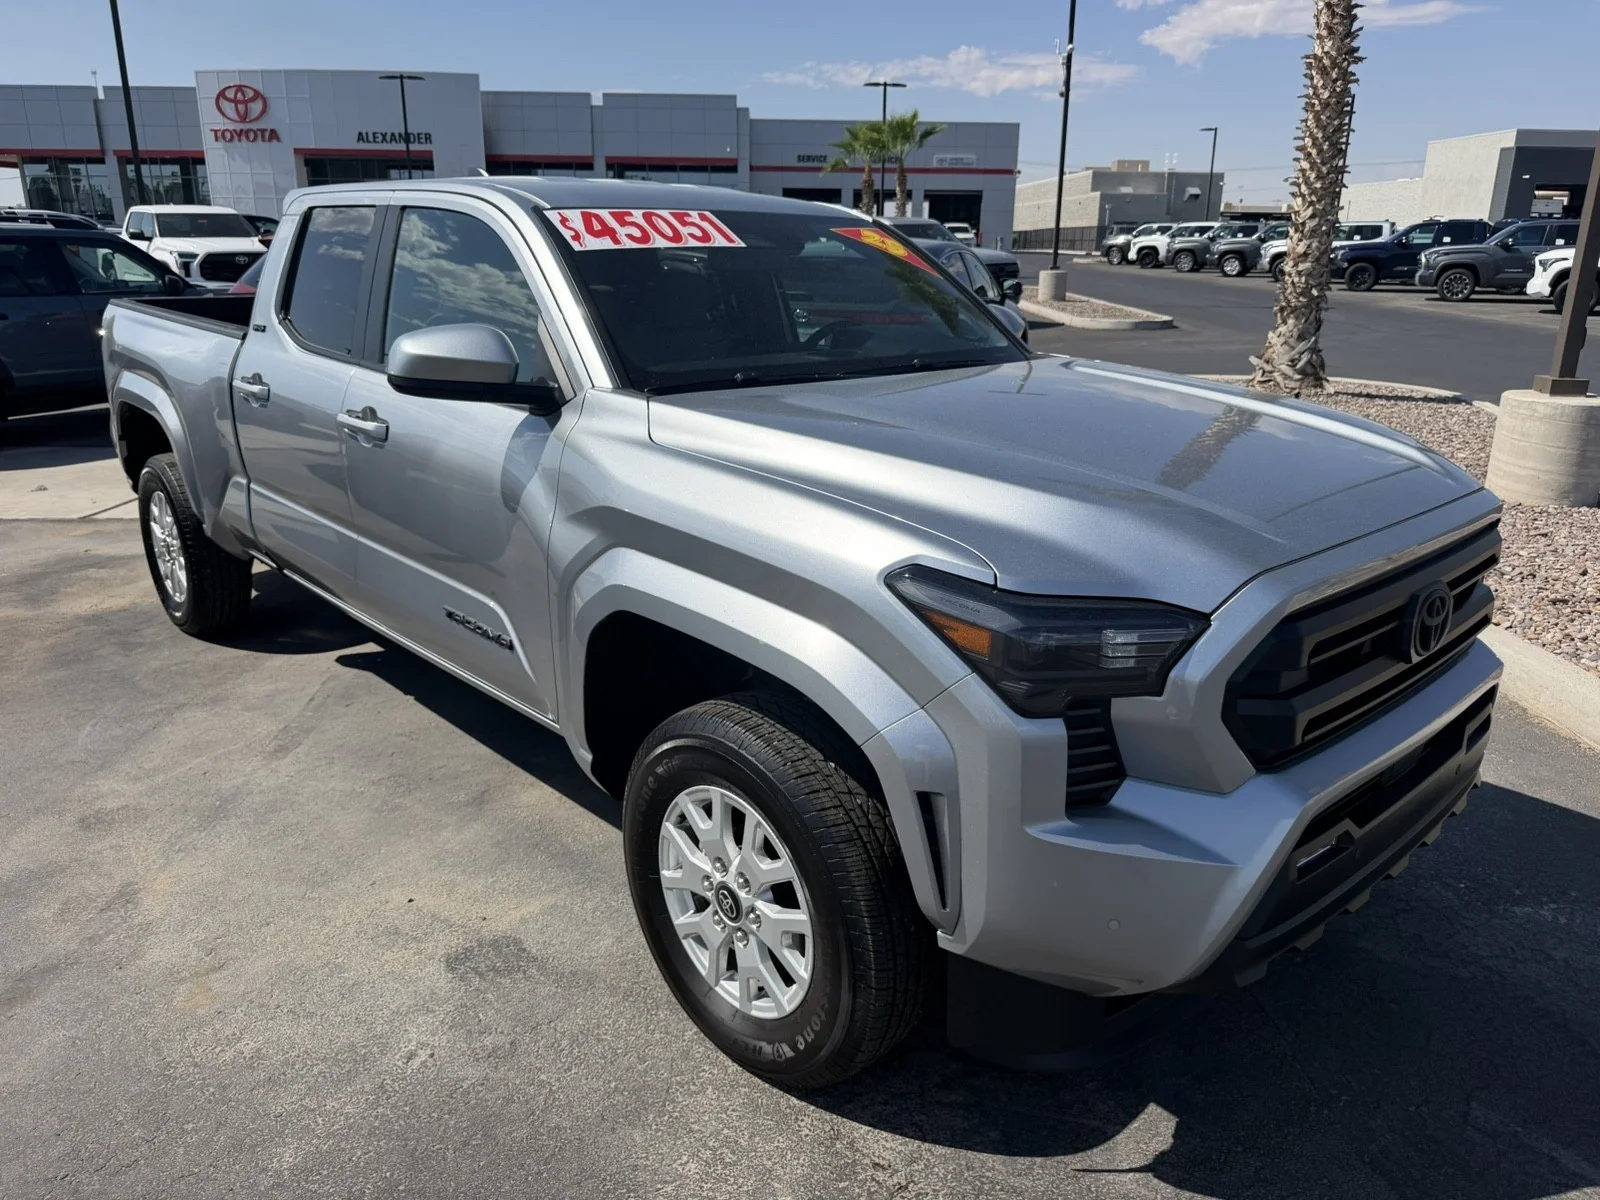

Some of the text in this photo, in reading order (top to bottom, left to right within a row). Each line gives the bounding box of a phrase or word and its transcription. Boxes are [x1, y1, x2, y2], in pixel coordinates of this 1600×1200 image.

[209, 127, 283, 143] TOYOTA
[356, 131, 433, 145] ALEXANDER
[796, 154, 828, 164] SERVICE
[556, 210, 738, 248] $45051
